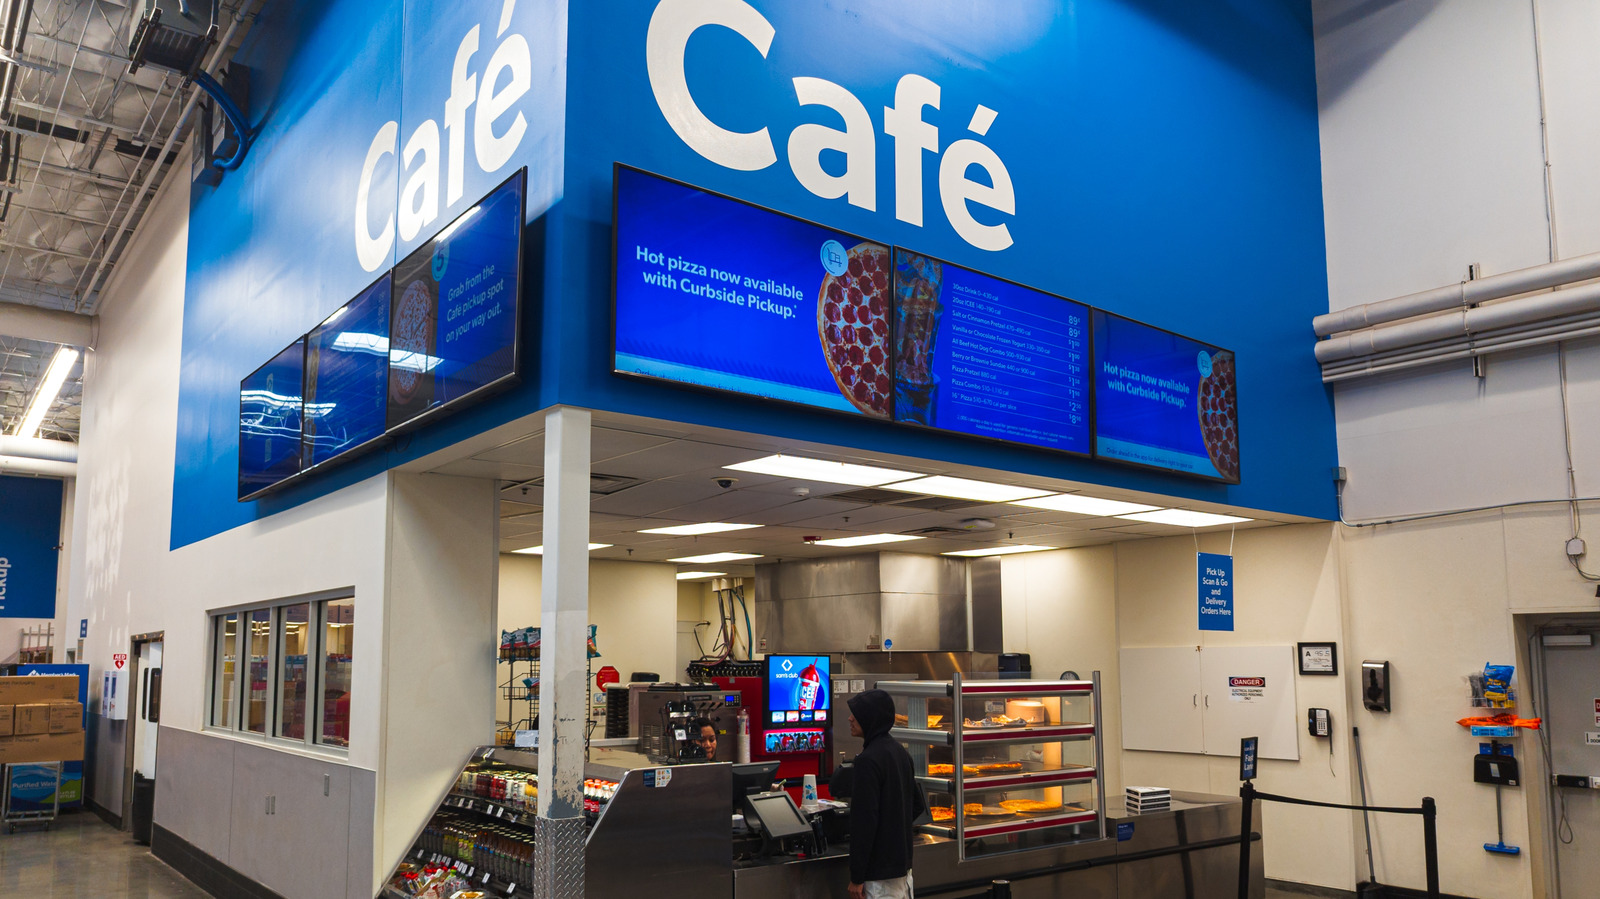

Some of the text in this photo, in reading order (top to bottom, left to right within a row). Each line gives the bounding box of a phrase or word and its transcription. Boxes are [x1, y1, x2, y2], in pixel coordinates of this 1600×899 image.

[647, 0, 1016, 251] Café
[355, 0, 531, 273] Café
[636, 245, 803, 301] Hot pizza now available
[448, 264, 495, 301] Grab from the
[643, 271, 677, 290] with
[680, 278, 745, 306] Curbside
[462, 291, 486, 316] pickup
[485, 278, 504, 300] spot
[446, 302, 502, 342] on your way out.
[967, 314, 990, 325] Cinnamon
[990, 320, 1006, 329] Pretzel
[952, 324, 968, 334] Vanilla
[973, 330, 996, 341] Chocolate
[996, 336, 1011, 344] Frozen
[1011, 340, 1026, 348] Yogurt
[979, 345, 989, 353] Dog
[989, 347, 1006, 356] Combo
[952, 351, 964, 360] Berry
[970, 356, 989, 365] Brownie
[990, 361, 1006, 369] Sundae
[952, 365, 964, 373] Pizza
[964, 368, 980, 376] Pretzel
[1103, 361, 1190, 394] Hot pizza now available
[964, 381, 981, 390] Combo
[1107, 380, 1125, 392] with
[1126, 382, 1160, 401] Curbside
[960, 394, 973, 402] Pizza
[1203, 577, 1215, 585] Scan
[1216, 578, 1220, 586] &
[1206, 568, 1225, 578] Pick Up
[0, 557, 12, 610] ickup
[1205, 597, 1227, 607] Delivery
[1201, 607, 1232, 616] Orders Here
[1244, 754, 1254, 762] Fast
[1244, 763, 1254, 771] Lane
